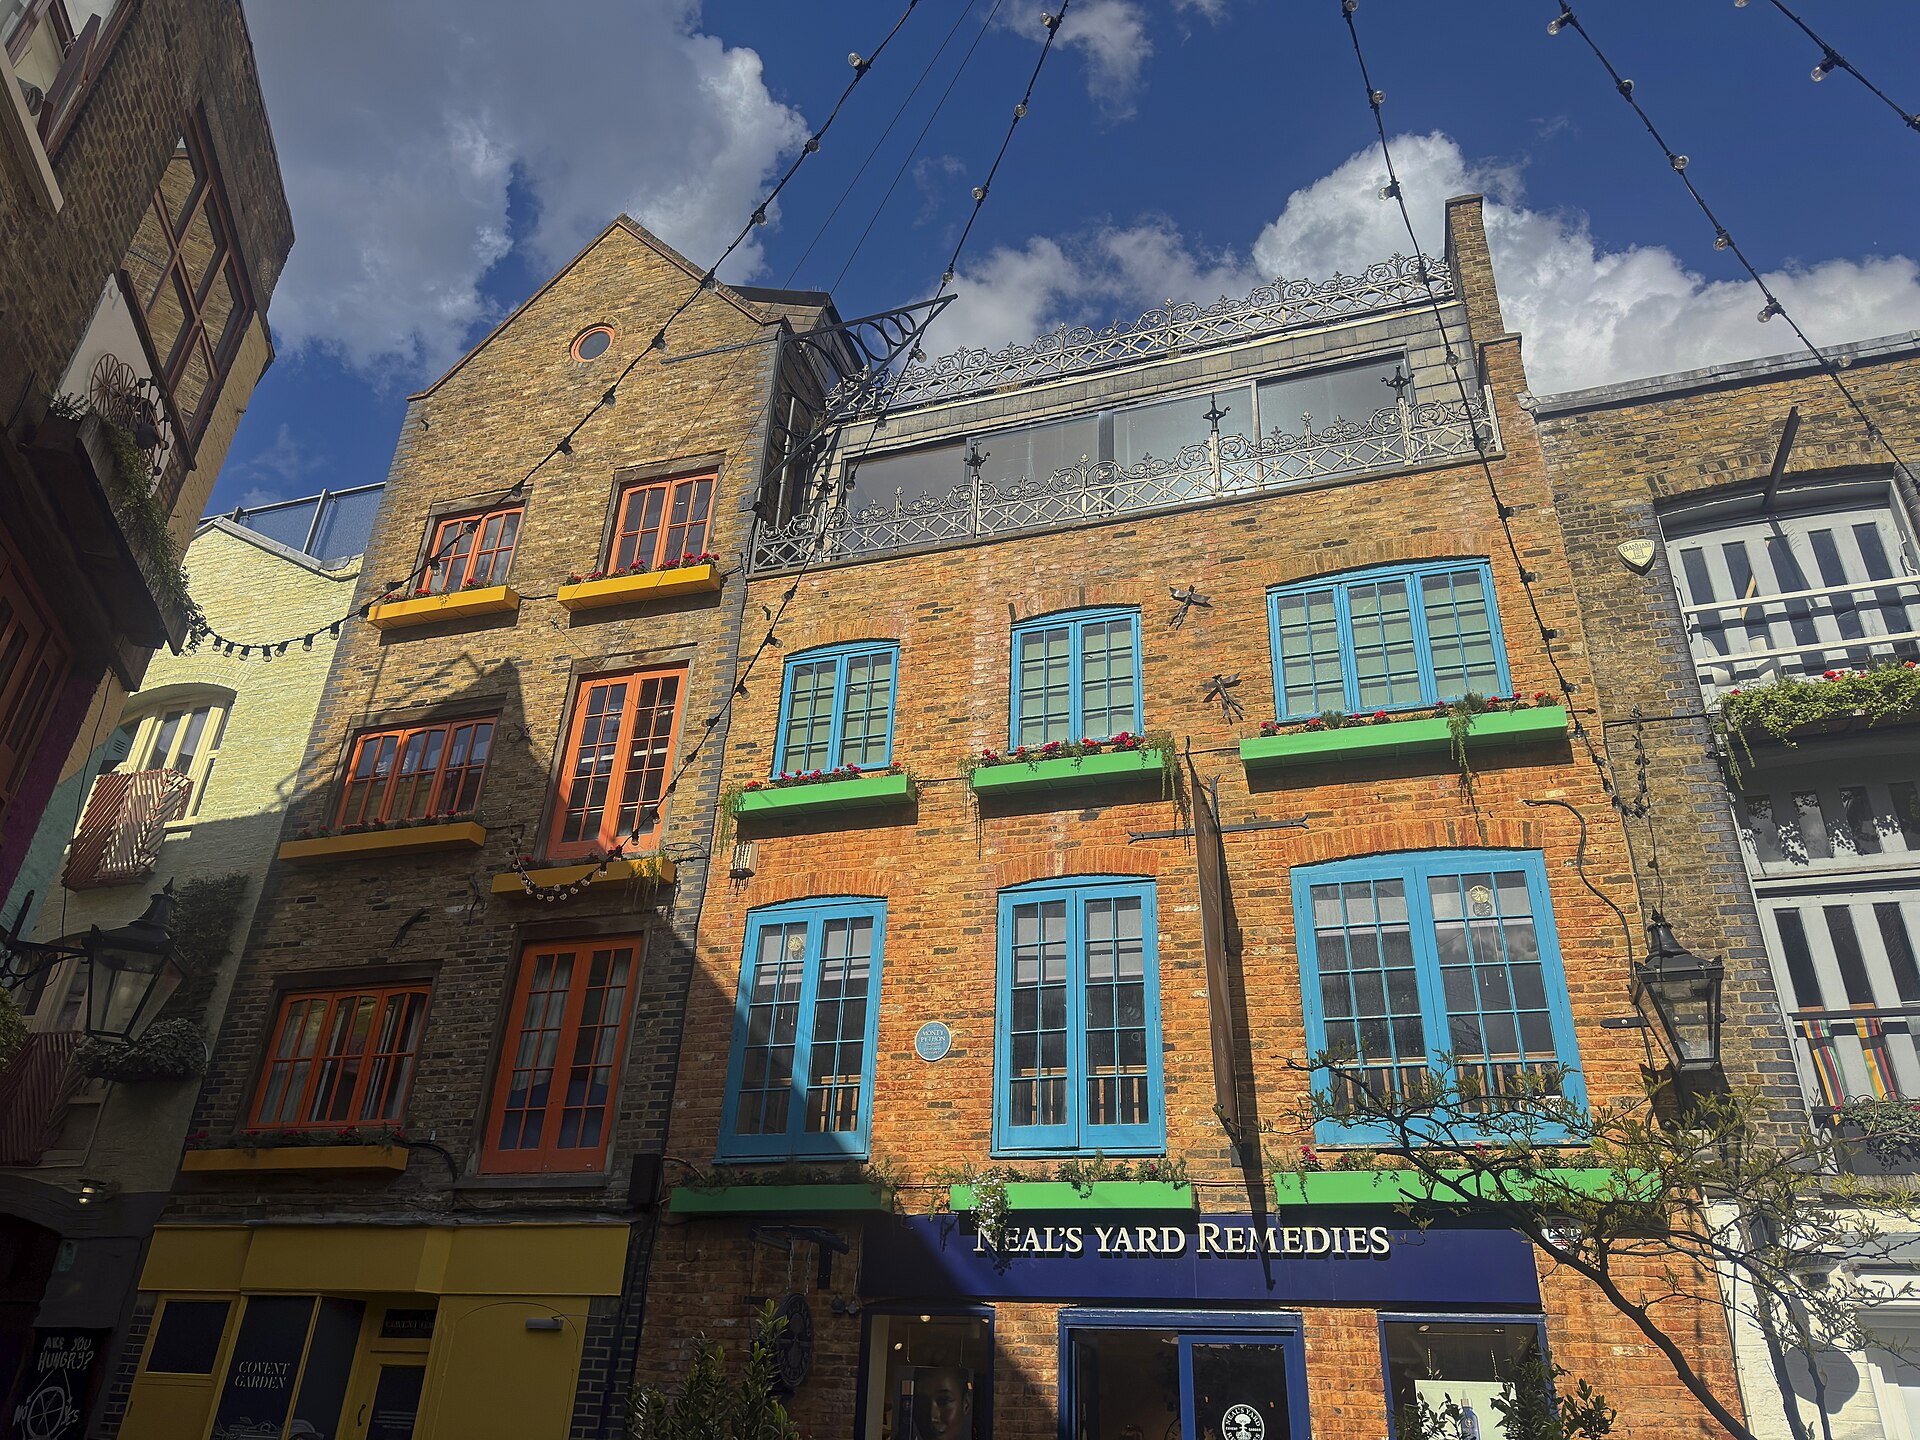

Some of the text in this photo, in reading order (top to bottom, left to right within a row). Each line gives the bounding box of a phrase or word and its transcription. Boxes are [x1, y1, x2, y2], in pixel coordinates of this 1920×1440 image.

[1622, 541, 1652, 553] BANHAM
[972, 1222, 1390, 1254] NEAL'S YARD REMEDIES
[43, 1336, 92, 1351] ARE YOU
[37, 1350, 95, 1373] HUNGRY?
[238, 1360, 291, 1375] COVENT
[234, 1375, 288, 1389] GARDEN
[1225, 1407, 1261, 1427] NEAL'S YARD
